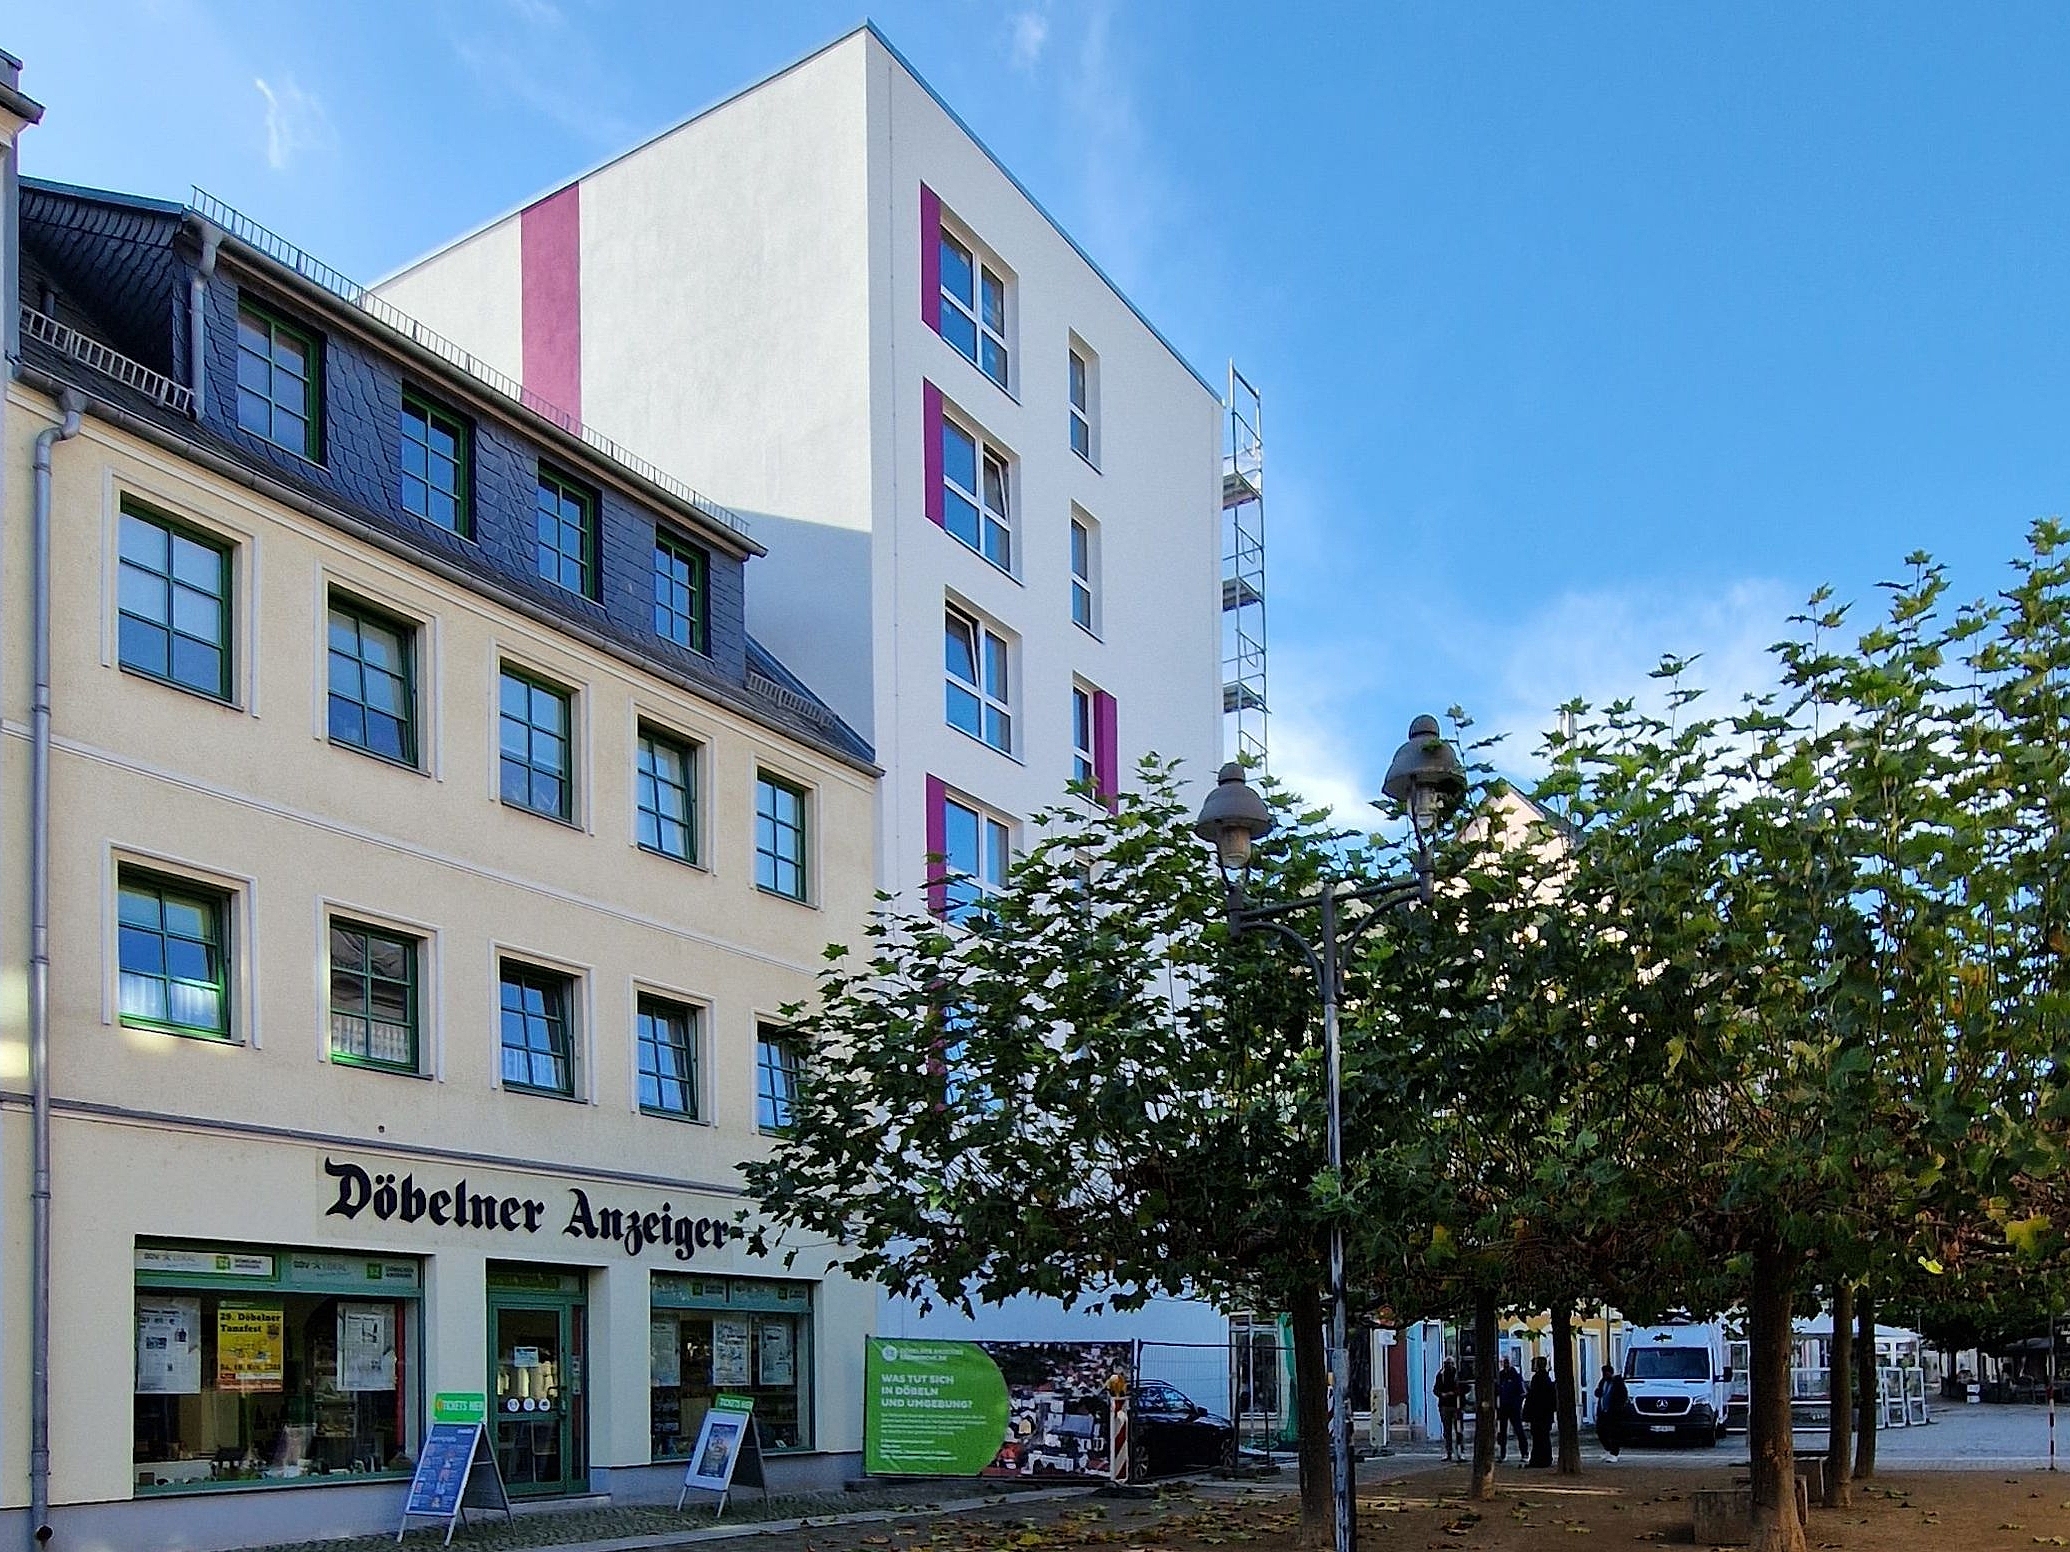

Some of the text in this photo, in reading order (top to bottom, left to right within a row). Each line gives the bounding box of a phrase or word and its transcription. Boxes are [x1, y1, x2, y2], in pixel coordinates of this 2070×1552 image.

[325, 1156, 730, 1261] Döbelner Anzeiger
[220, 1324, 262, 1333] Tanzfest
[881, 1373, 955, 1385] WAS TUT SICH
[881, 1384, 939, 1396] IN DÖBELN
[881, 1398, 974, 1409] UND UMGEBUNG?
